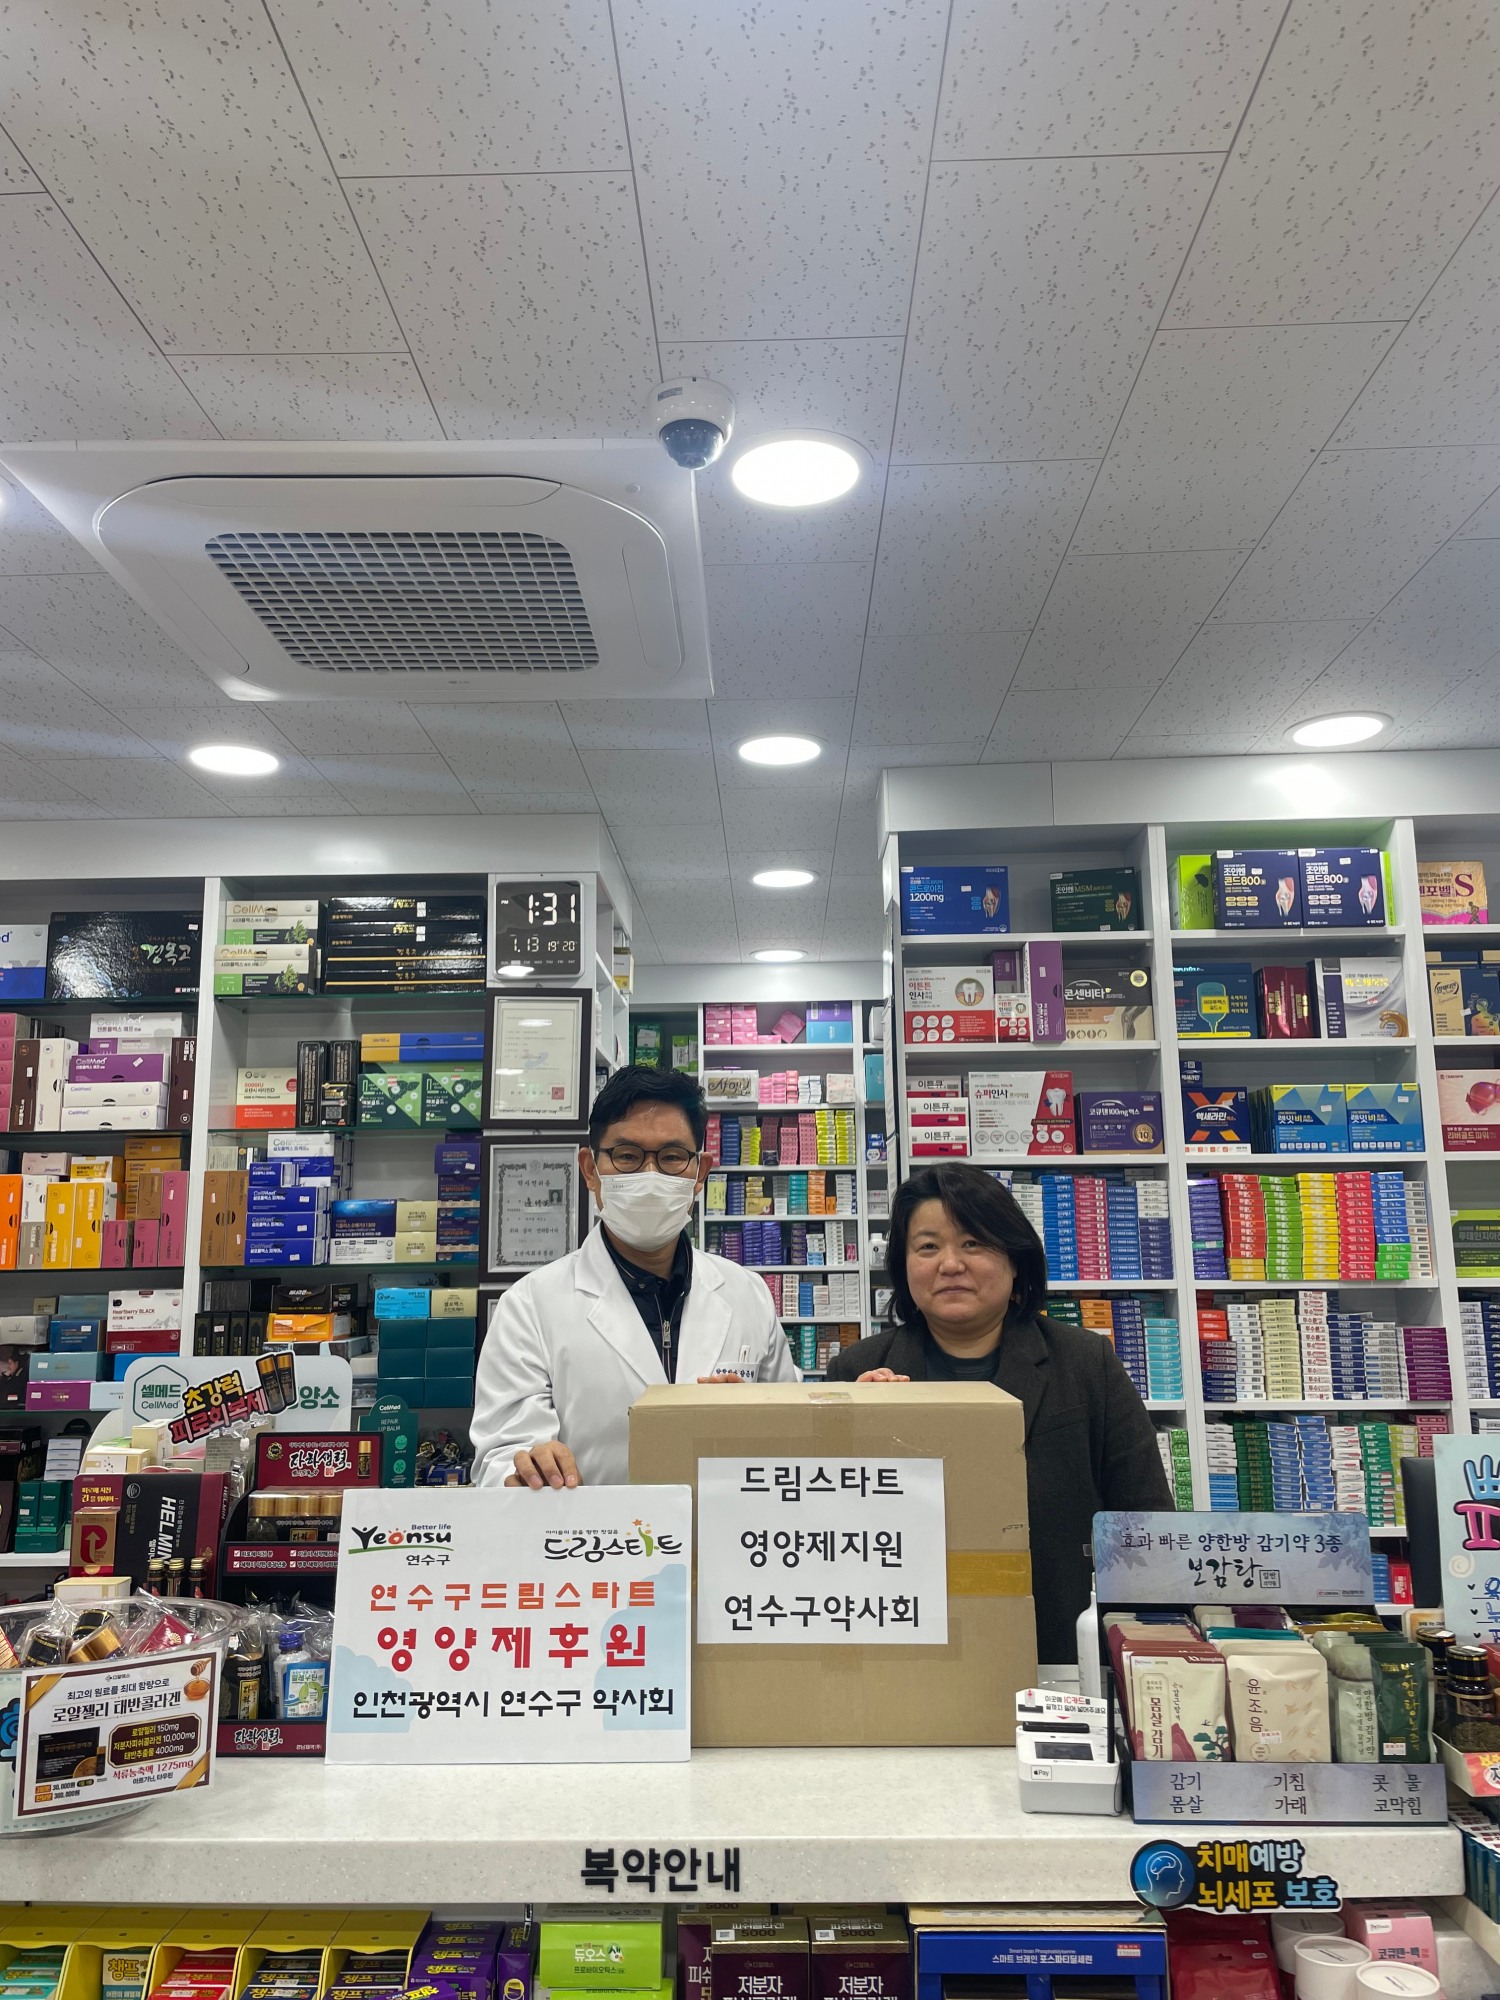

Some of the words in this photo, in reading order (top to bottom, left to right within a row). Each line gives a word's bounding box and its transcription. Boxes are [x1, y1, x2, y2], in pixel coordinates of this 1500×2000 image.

[909, 885, 944, 893] 콘드로이친
[1074, 885, 1093, 893] MSM
[1455, 874, 1474, 897] S
[909, 893, 944, 902] 1200mg
[528, 892, 576, 925] 1:31
[1064, 988, 1105, 1000] 콘센비타
[141, 1384, 182, 1399] 셀메드
[183, 1370, 243, 1413] 초강력
[141, 1400, 180, 1410] CellMed
[740, 1466, 903, 1502] 드림스타트
[411, 1523, 437, 1531] Better
[438, 1523, 451, 1531] life
[351, 1526, 452, 1550] Yeonsu
[544, 1526, 683, 1562] 드림스타트
[1121, 1528, 1152, 1550] 효과
[1159, 1532, 1192, 1550] 빠른
[1198, 1533, 1250, 1552] 양한방
[1257, 1533, 1310, 1553] 감기약
[1315, 1533, 1343, 1554] 3종
[740, 1530, 903, 1568] 영양제지원
[406, 1553, 451, 1566] 연수구
[1189, 1556, 1263, 1589] 보감탕
[370, 1580, 656, 1612] 연수구드림스타트
[724, 1594, 920, 1632] 연수구약사회
[67, 1690, 92, 1700] 최고의
[94, 1685, 119, 1696] 원료를
[120, 1682, 137, 1692] 최대
[138, 1678, 170, 1691] 함량으로
[52, 1701, 109, 1722] 로얄젤리
[113, 1690, 182, 1714] 태반콜라겐
[353, 1690, 490, 1719] 인천광역시
[500, 1690, 582, 1717] 연수구
[593, 1687, 674, 1716] 약사회
[157, 1723, 180, 1733] 150mg
[163, 1731, 195, 1744] 10,000mg
[155, 1744, 184, 1755] 4000mg
[157, 1759, 194, 1772] 1275mg
[1170, 1773, 1201, 1790] 감기
[1273, 1773, 1305, 1792] 기침
[1170, 1796, 1204, 1814] 몸살
[1275, 1796, 1307, 1815] 가래
[1374, 1796, 1422, 1816] 코막힘
[1197, 1842, 1302, 1874] 치매예방
[581, 1847, 740, 1893] 복약안내
[1197, 1880, 1279, 1910] 뇌세포
[1285, 1878, 1338, 1908] 보호
[741, 1929, 777, 1937] 5000
[841, 1929, 876, 1937] 5000
[574, 1949, 607, 1962] 듀오스
[992, 1955, 1014, 1964] 스마트
[1016, 1955, 1038, 1964] 브레인
[108, 1958, 140, 1981] 챔프
[574, 1966, 617, 1974] 프로바이오틱스
[738, 1976, 783, 1995] 저분자
[838, 1976, 884, 1995] 저분자
